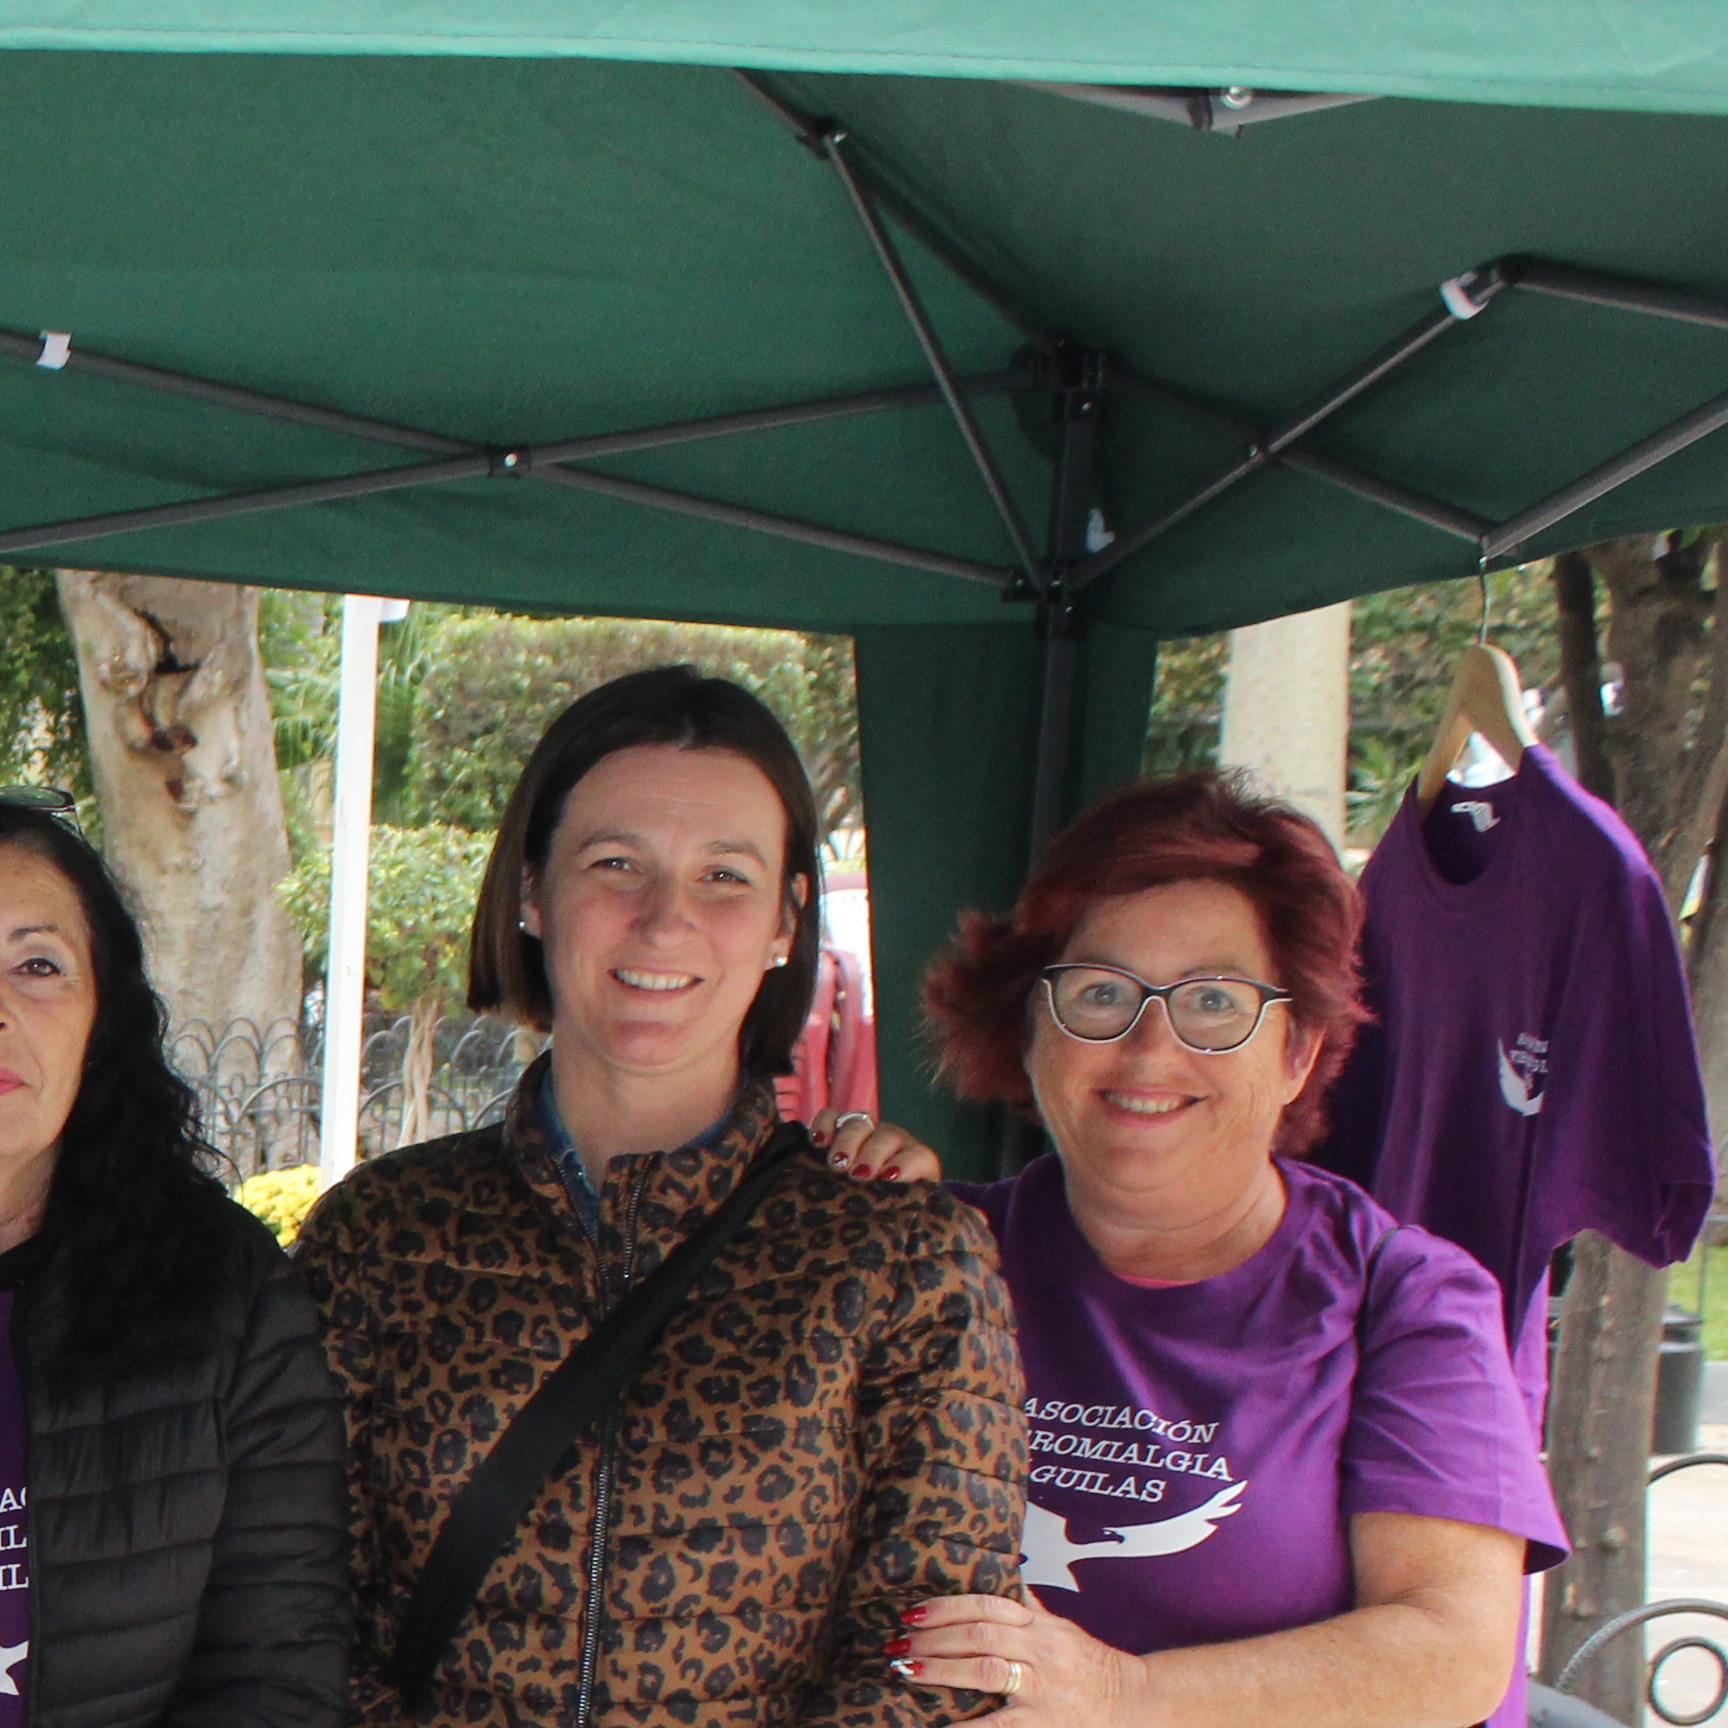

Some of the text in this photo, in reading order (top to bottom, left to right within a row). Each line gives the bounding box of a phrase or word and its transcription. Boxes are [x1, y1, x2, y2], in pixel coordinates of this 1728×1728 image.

[1024, 1397, 1220, 1444] ASOCIACIÓN
[1028, 1429, 1235, 1483] ROMIALGIA
[1028, 1458, 1167, 1503] GUILAS
